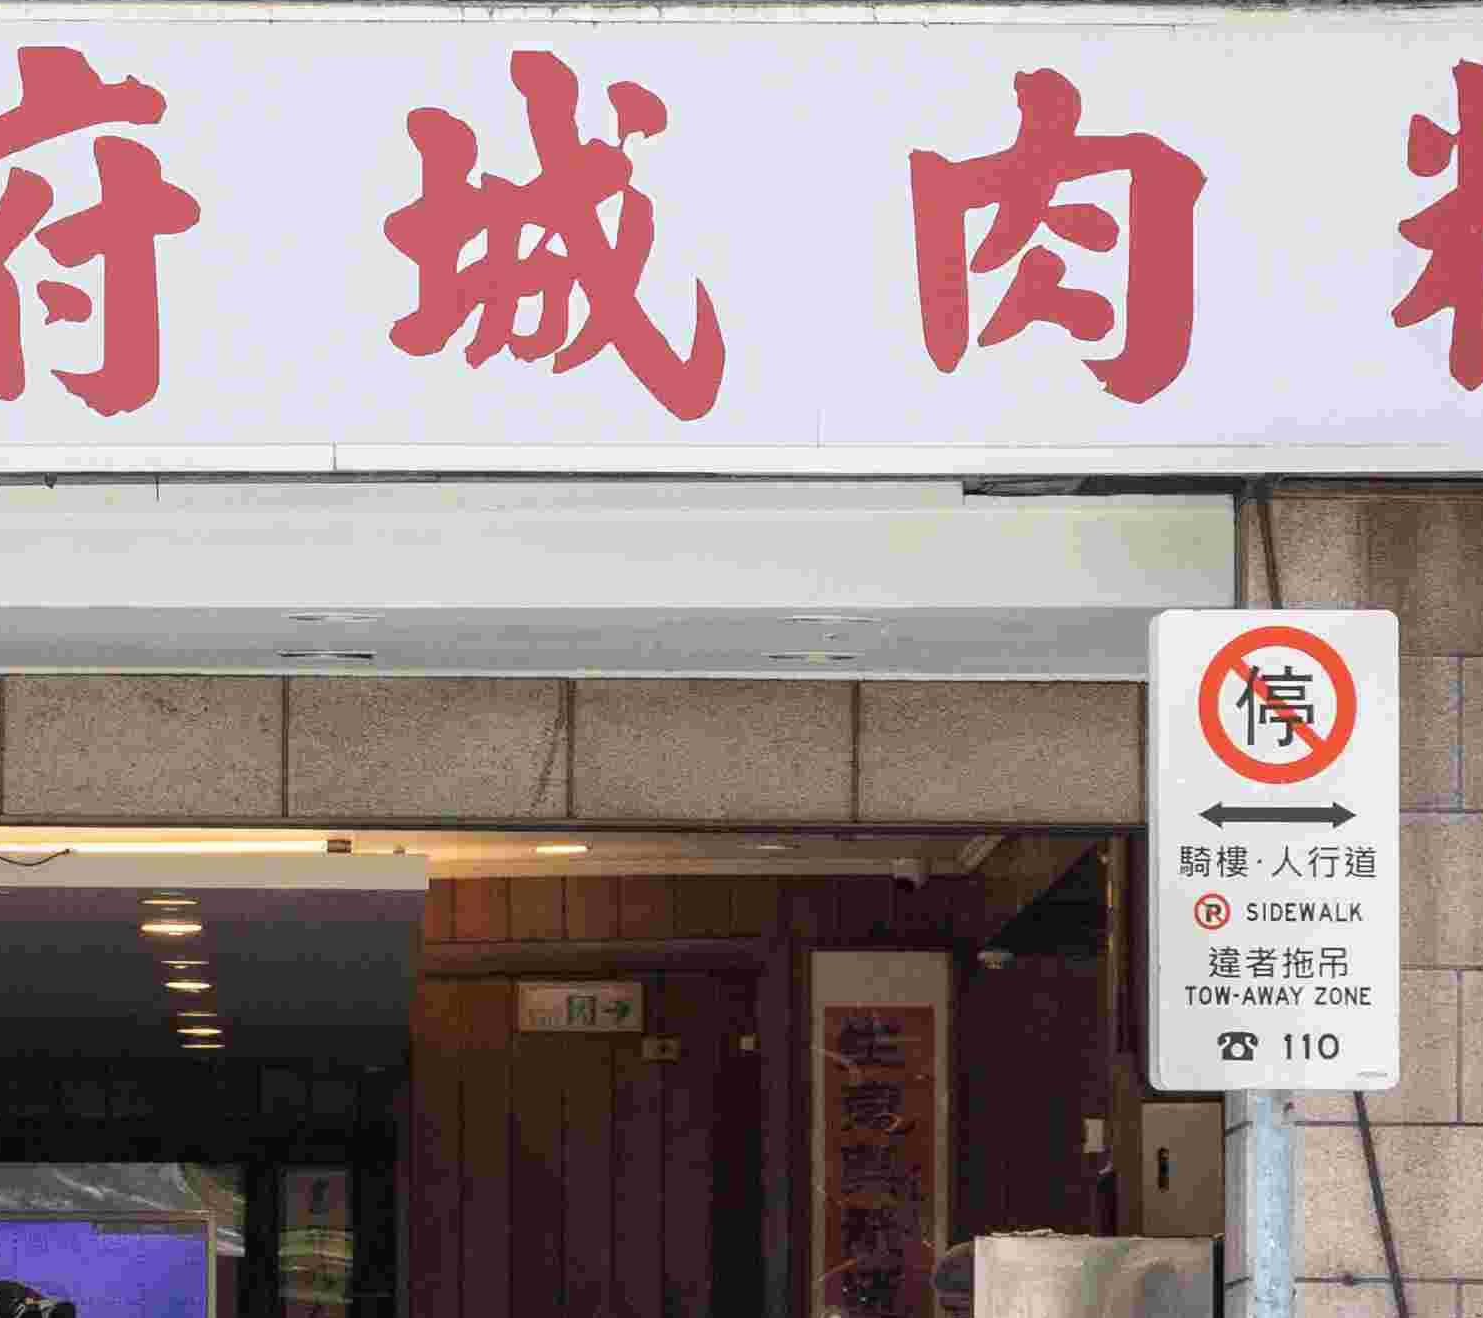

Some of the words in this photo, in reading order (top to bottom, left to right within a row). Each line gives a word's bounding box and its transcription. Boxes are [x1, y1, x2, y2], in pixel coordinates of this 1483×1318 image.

[1235, 665, 1315, 748] 停
[1245, 903, 1364, 923] SIDEWALK
[1207, 945, 1350, 980] 違者拖吊
[1184, 985, 1304, 1007] TOW-AWAY
[1314, 985, 1373, 1007] ZONE
[1283, 1033, 1341, 1061] 110
